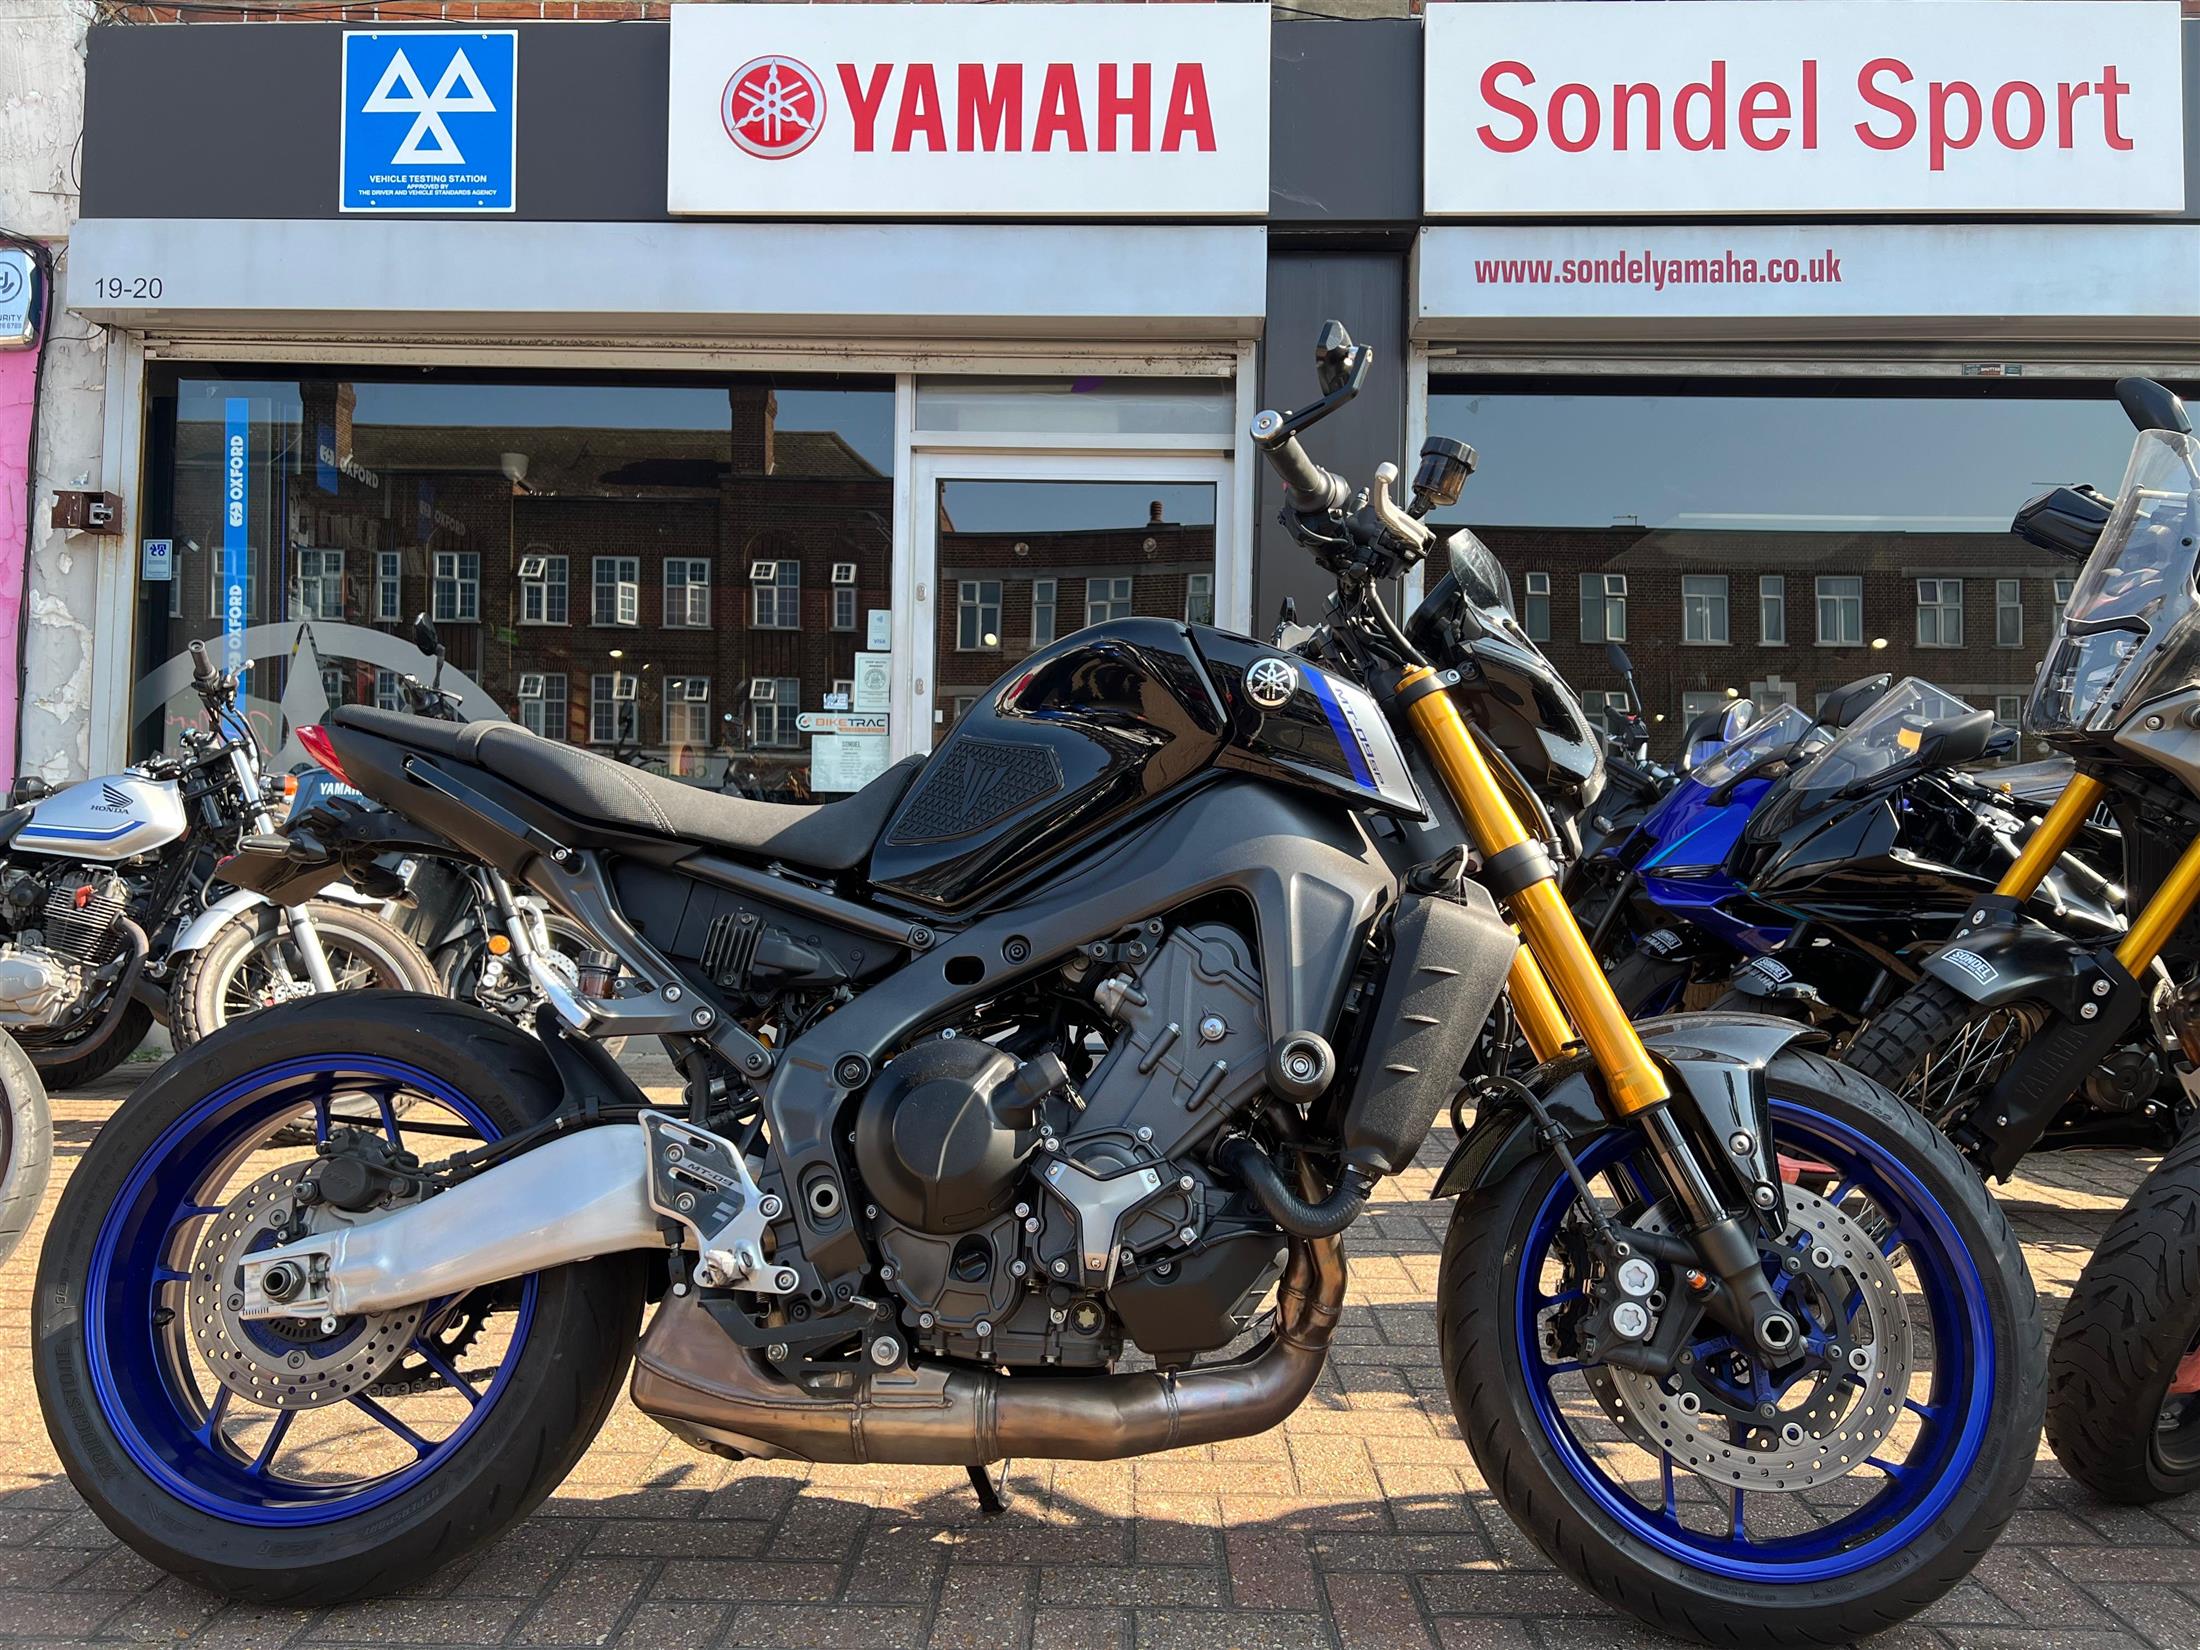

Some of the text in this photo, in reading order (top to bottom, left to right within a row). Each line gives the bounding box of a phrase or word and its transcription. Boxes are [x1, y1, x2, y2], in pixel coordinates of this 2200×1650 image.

[836, 62, 1218, 153] YAMAHA
[1475, 57, 2134, 171] Sondel Sport
[369, 174, 487, 183] VEHICLE TESTING STATION
[1474, 249, 1843, 292] www.sondelyamaha.co.uk
[95, 277, 163, 299] 19-20
[229, 434, 244, 500] OXFORD
[339, 455, 379, 489] OXFORD
[434, 509, 466, 537] OXFORD
[228, 584, 243, 650] OXFORD
[815, 718, 886, 727] BIKETRAC
[90, 804, 130, 815] HONDA
[1758, 958, 1787, 979] SONDEL
[1950, 950, 1991, 978] SONDEL
[687, 1163, 735, 1187] MT-09
